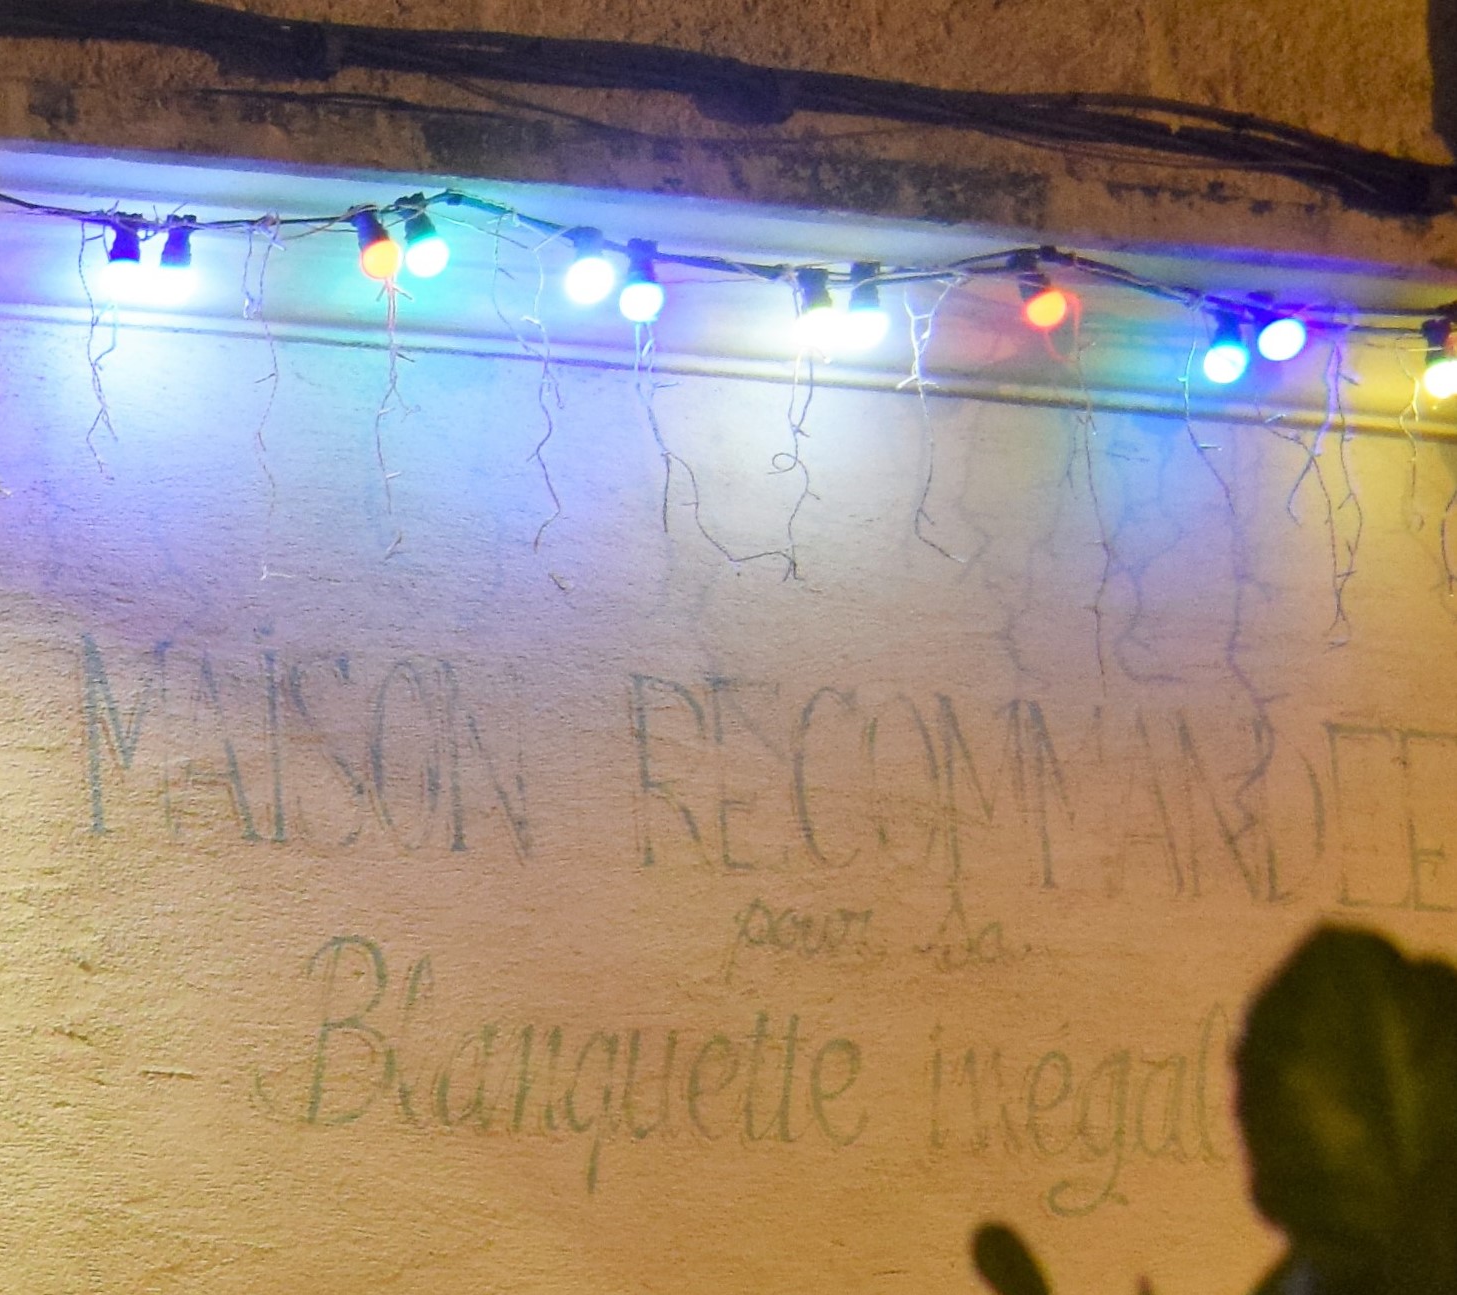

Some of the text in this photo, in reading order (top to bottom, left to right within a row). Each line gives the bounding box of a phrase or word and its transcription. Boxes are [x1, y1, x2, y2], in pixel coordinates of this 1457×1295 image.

[81, 628, 532, 865] MAISON
[728, 898, 876, 985] pour
[251, 934, 1232, 1217] Blanquette inégal
